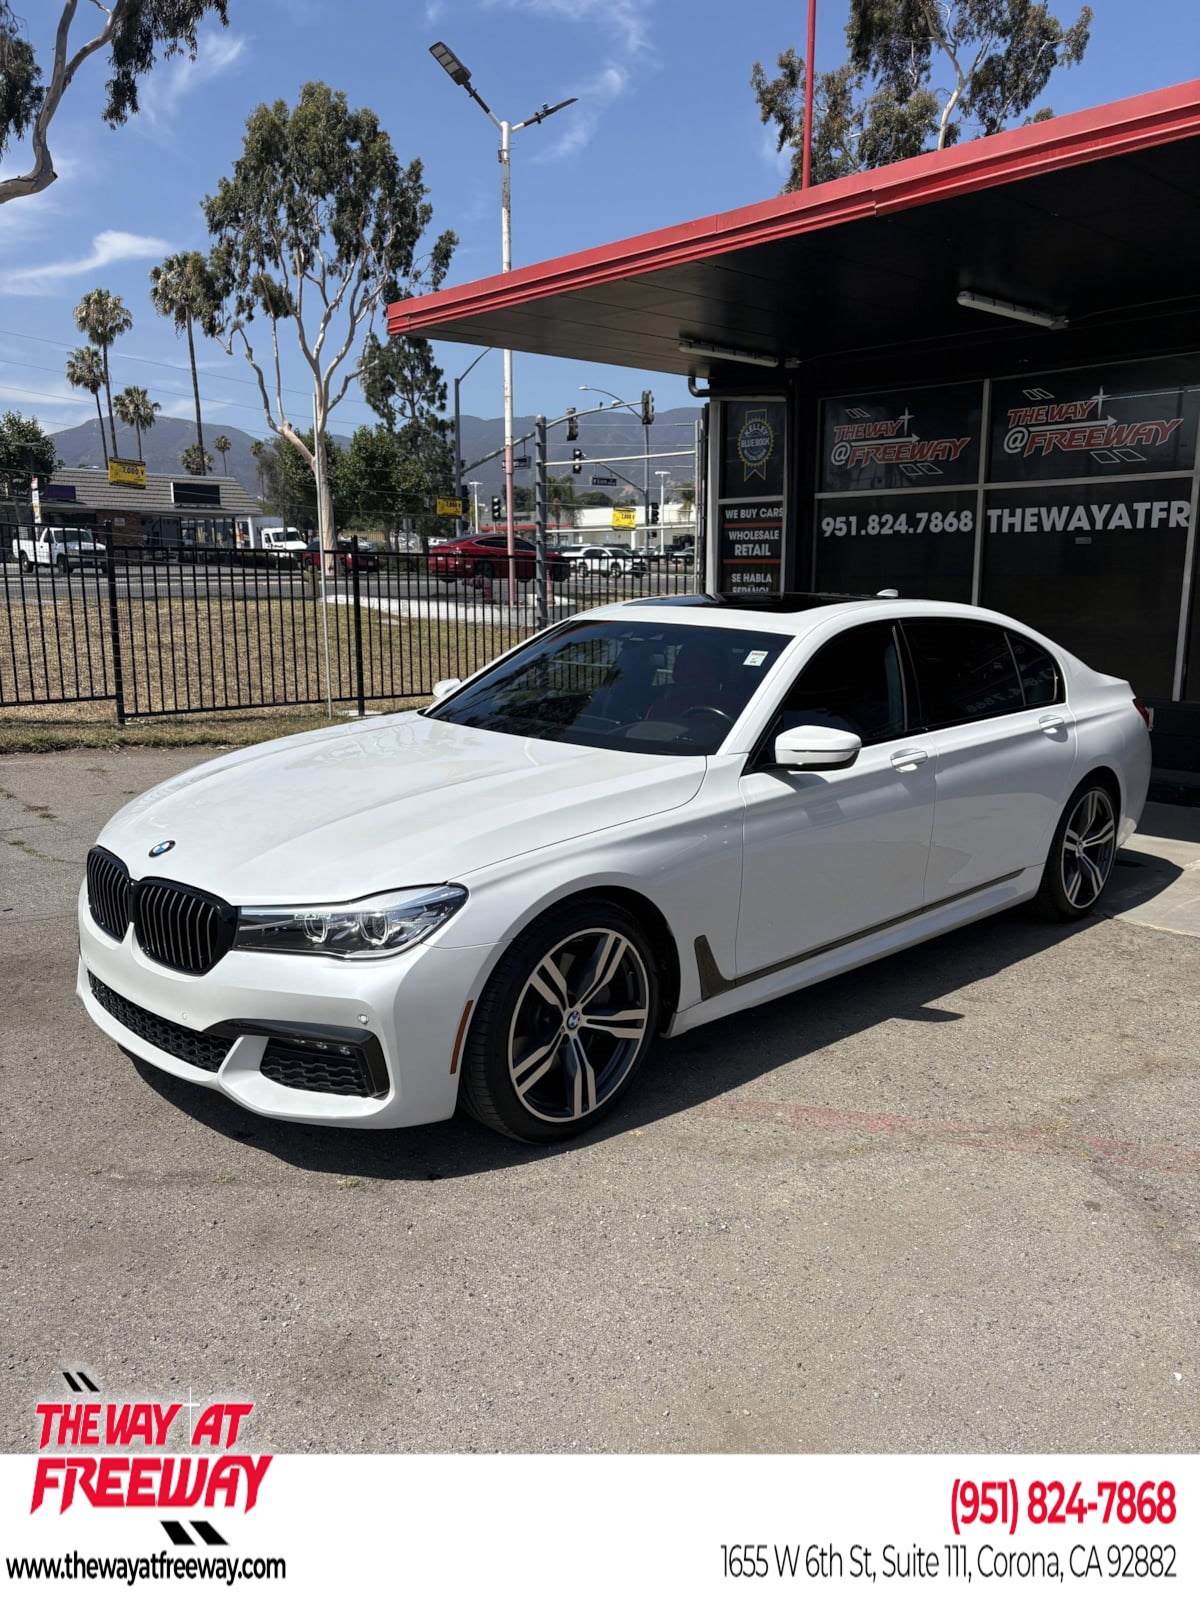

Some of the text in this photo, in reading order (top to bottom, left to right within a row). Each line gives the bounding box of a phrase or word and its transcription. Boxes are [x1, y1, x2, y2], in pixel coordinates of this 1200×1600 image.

[1008, 400, 1098, 426] THE WAY
[833, 419, 906, 441] THE WAY
[741, 438, 770, 448] BLUE BOOK
[725, 507, 784, 519] WE BUY CARS
[822, 510, 974, 537] 951.824.7868
[728, 530, 780, 541] WHOLESALE
[734, 543, 771, 556] RETAIL
[731, 573, 772, 583] SE HABLA
